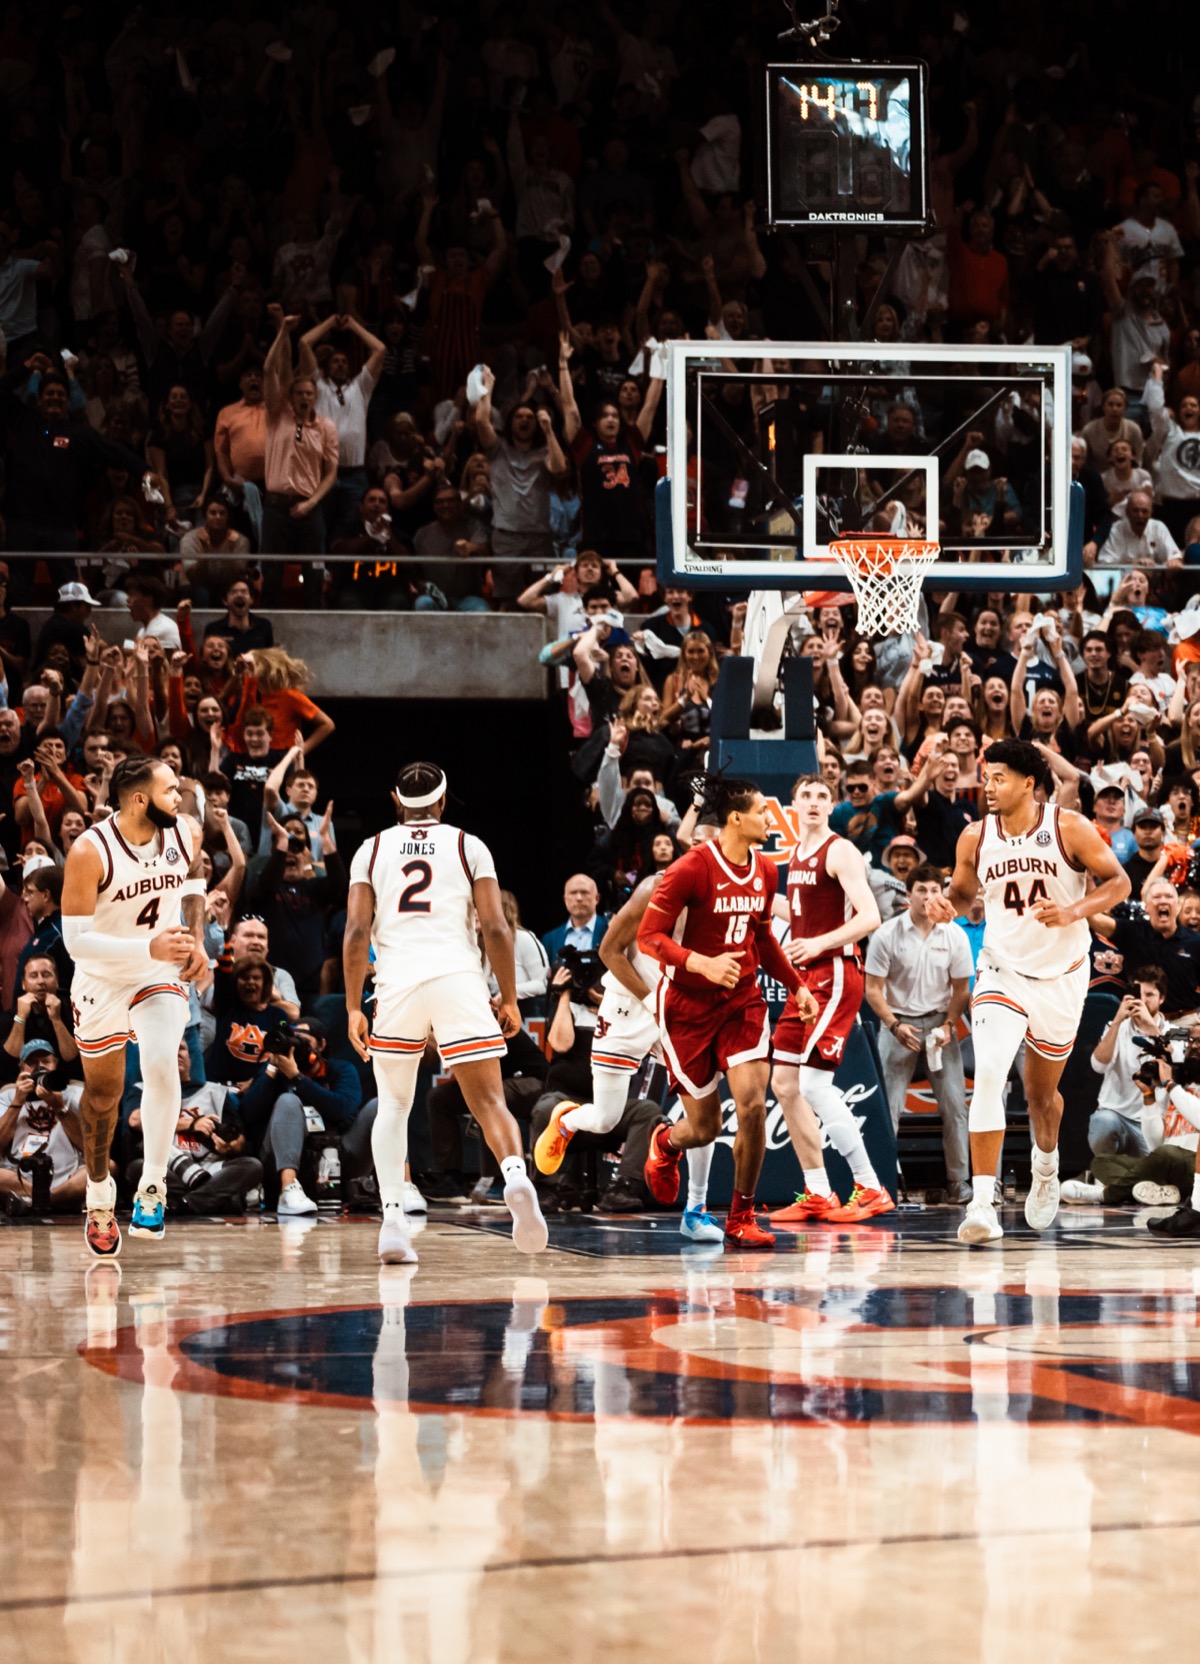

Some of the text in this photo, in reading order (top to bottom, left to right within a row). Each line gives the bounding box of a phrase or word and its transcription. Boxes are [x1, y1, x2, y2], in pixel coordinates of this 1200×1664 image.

[808, 212, 884, 221] DAKTRONICS
[684, 564, 723, 574] SPALDING
[400, 842, 435, 855] JONES
[985, 857, 1058, 883] AUBURN
[111, 874, 186, 902] AUBURN
[397, 859, 432, 913] 2
[1003, 878, 1051, 916] 44
[136, 896, 161, 930] 4
[713, 896, 765, 913] ALABAMA
[724, 914, 750, 944] 15
